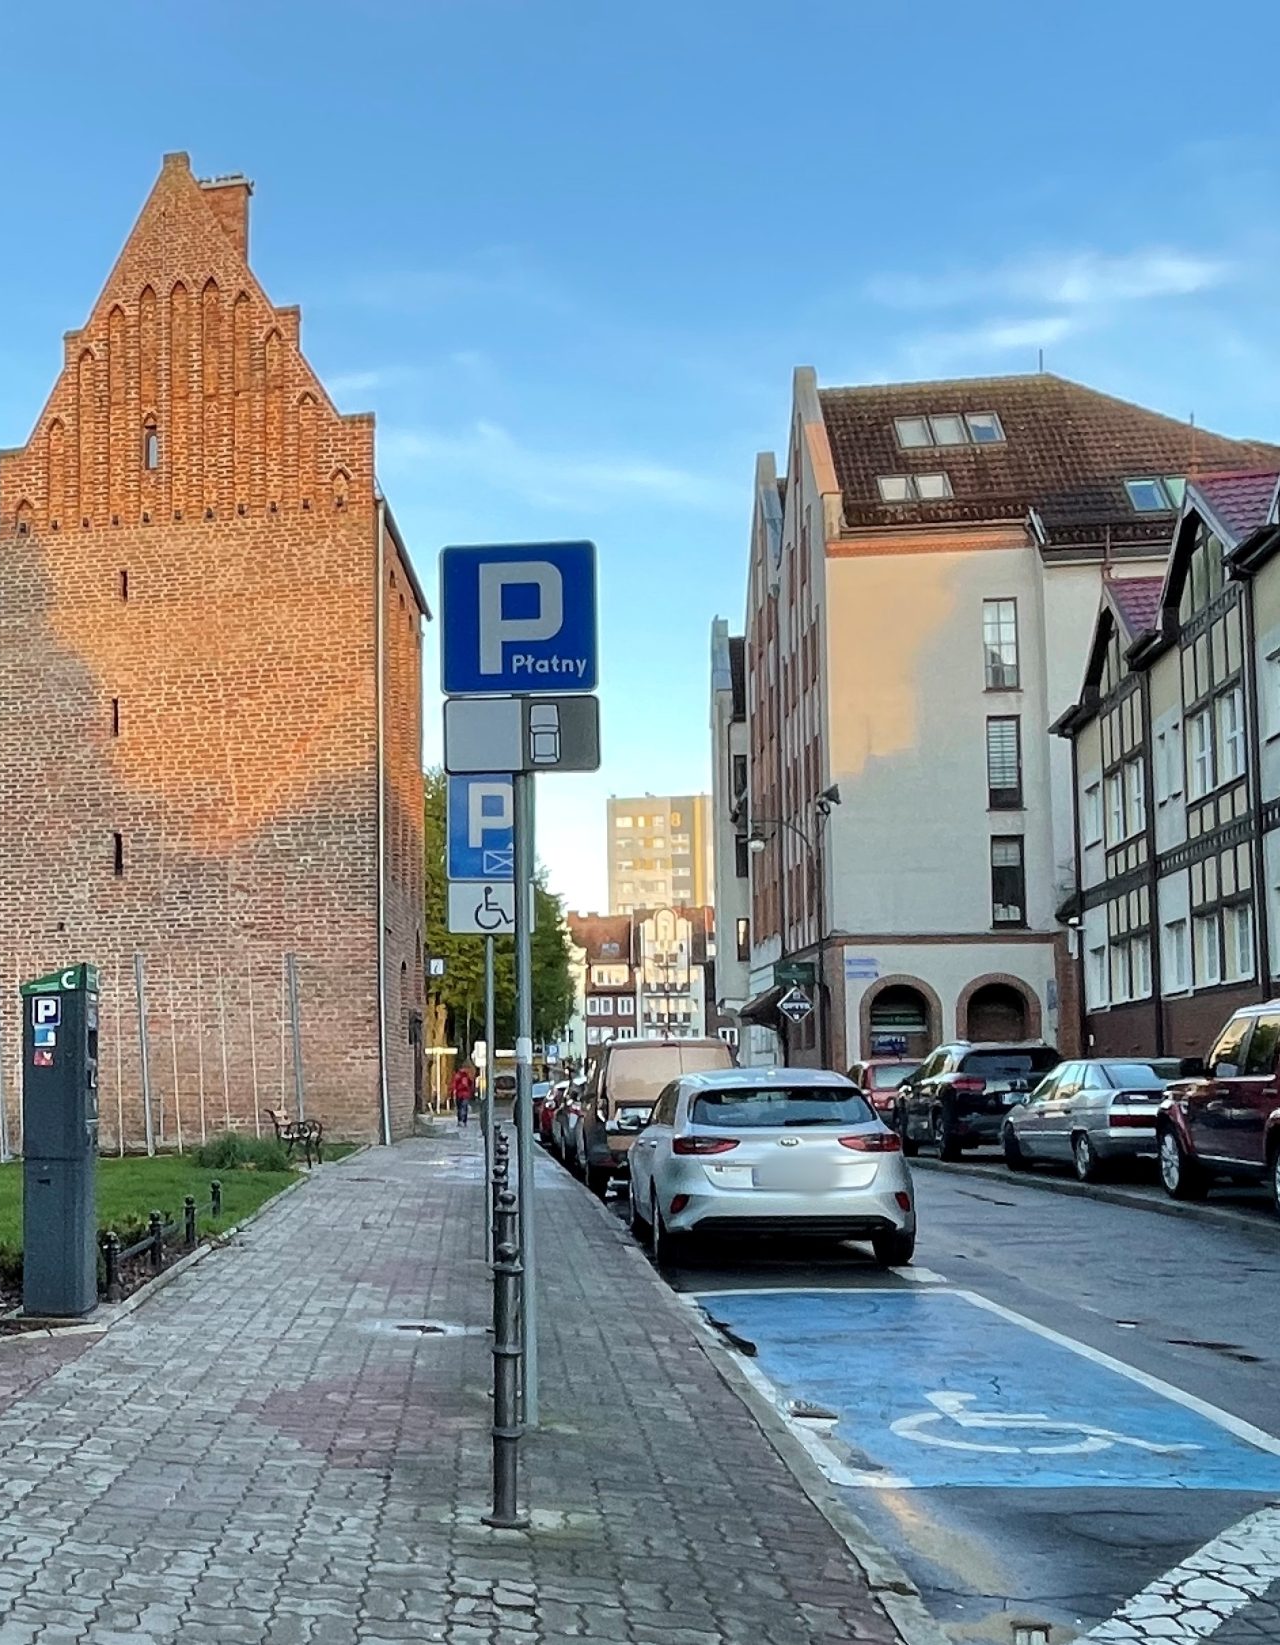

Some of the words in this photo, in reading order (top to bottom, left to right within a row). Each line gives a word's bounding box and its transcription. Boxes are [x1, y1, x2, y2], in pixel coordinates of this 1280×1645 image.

[479, 561, 563, 675] P
[512, 653, 587, 678] Płatny
[468, 782, 513, 848] P
[60, 970, 76, 989] C
[37, 999, 57, 1023] P
